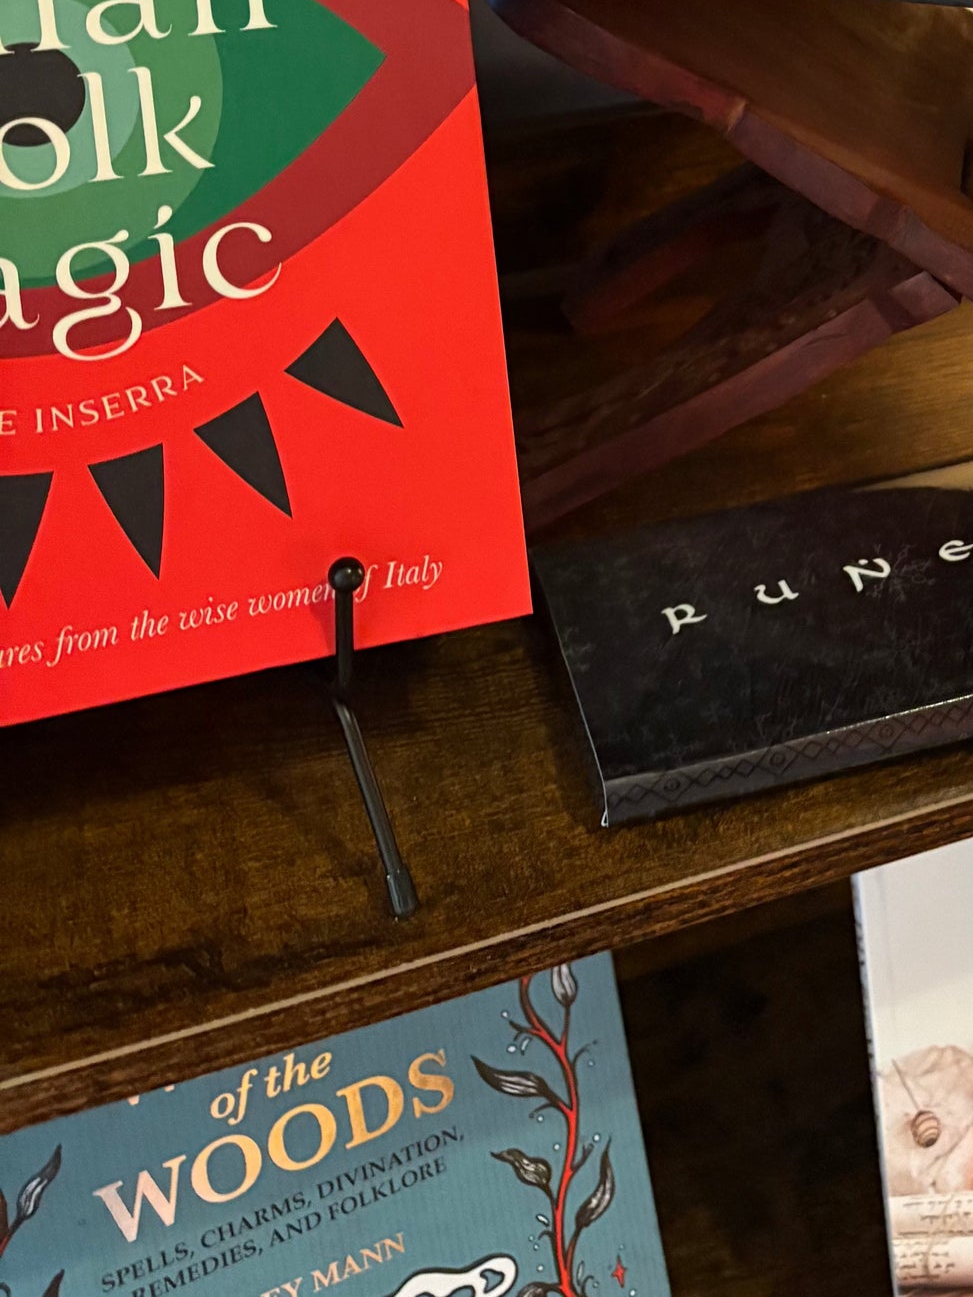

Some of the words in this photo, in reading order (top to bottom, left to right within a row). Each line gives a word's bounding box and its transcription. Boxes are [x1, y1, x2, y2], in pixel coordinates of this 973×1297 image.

[35, 364, 205, 434] INSERRA
[46, 625, 119, 667] from
[130, 609, 169, 641] the
[179, 596, 239, 630] wise
[353, 565, 378, 603] f
[384, 555, 443, 590] Italy
[210, 1068, 258, 1126] of
[264, 1052, 333, 1099] the
[92, 1049, 455, 1243] WOODS
[100, 1240, 196, 1294] SPELLS,
[200, 1190, 314, 1248] CHARMS,
[316, 1126, 465, 1201] DIVINATION,
[131, 1238, 264, 1297] REMEDIES,
[269, 1209, 322, 1247] AND
[328, 1156, 448, 1221] FOLKLORE
[312, 1232, 407, 1294] MANN
